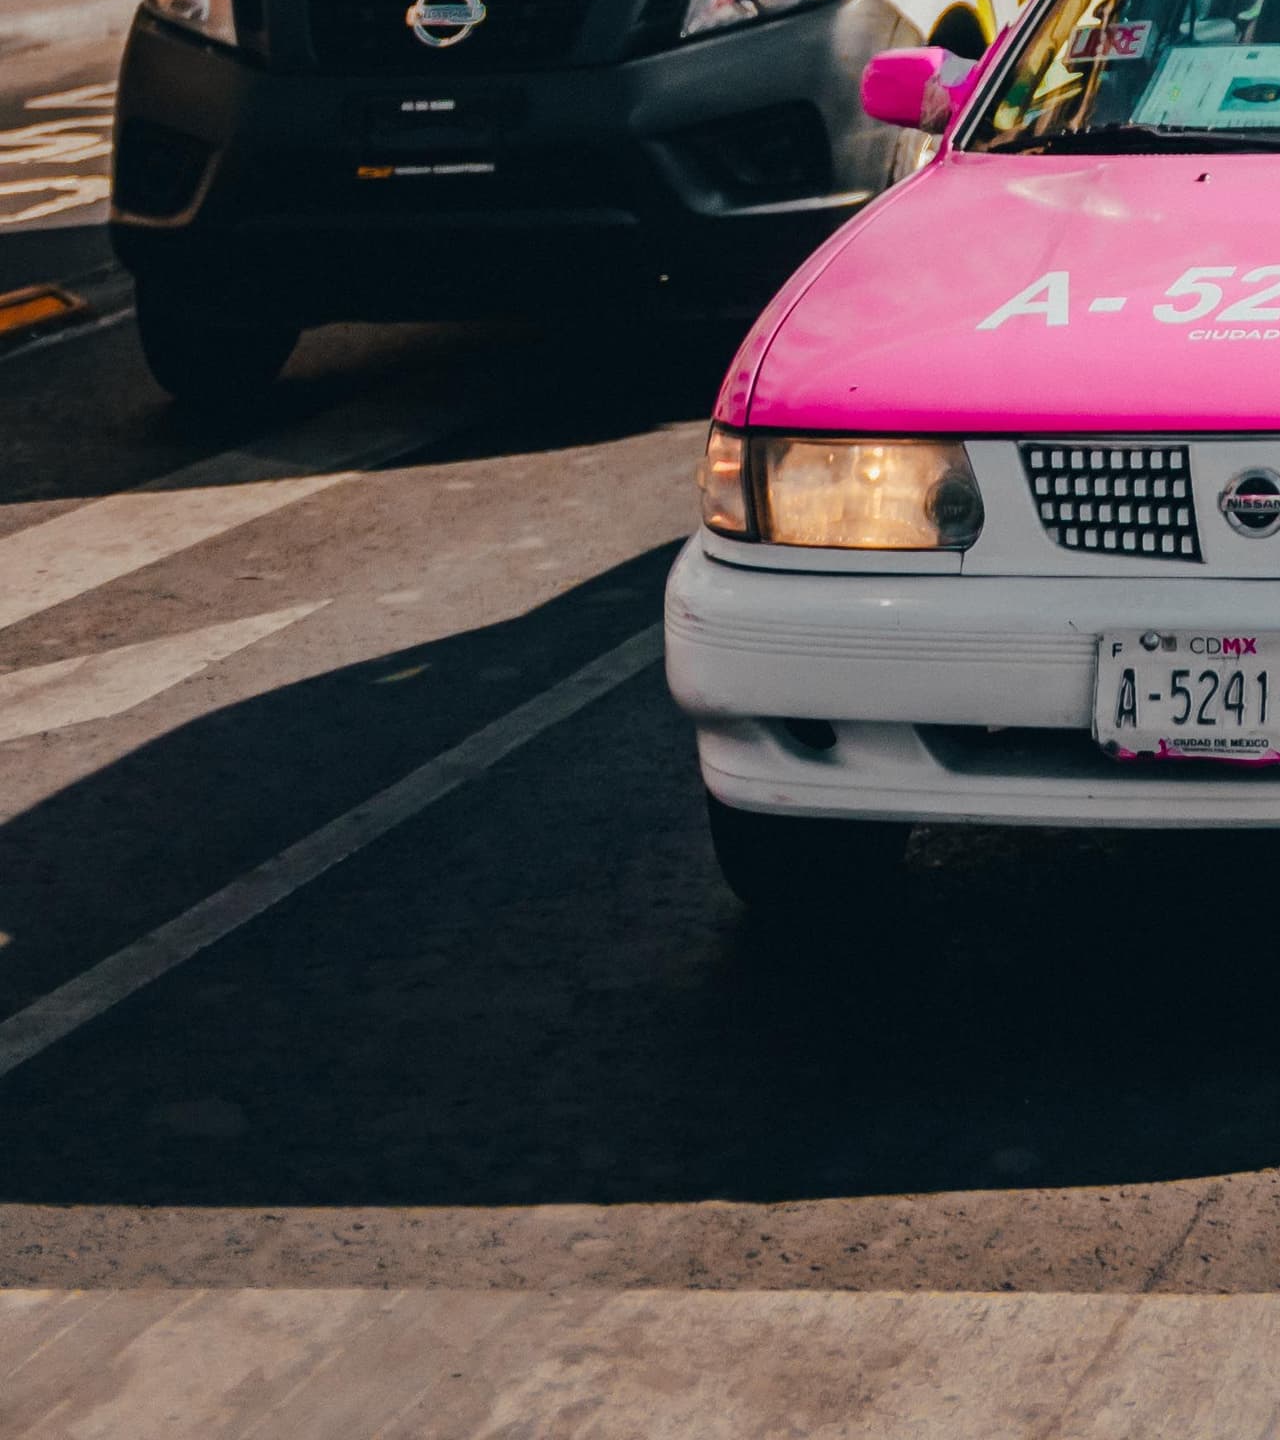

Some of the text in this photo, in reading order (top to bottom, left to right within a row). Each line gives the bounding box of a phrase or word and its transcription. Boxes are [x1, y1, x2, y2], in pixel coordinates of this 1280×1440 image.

[1188, 328, 1280, 341] CIUDAD
[1111, 636, 1257, 658] F CDMX
[1173, 738, 1211, 747] CIUDAD
[1214, 738, 1227, 747] DE
